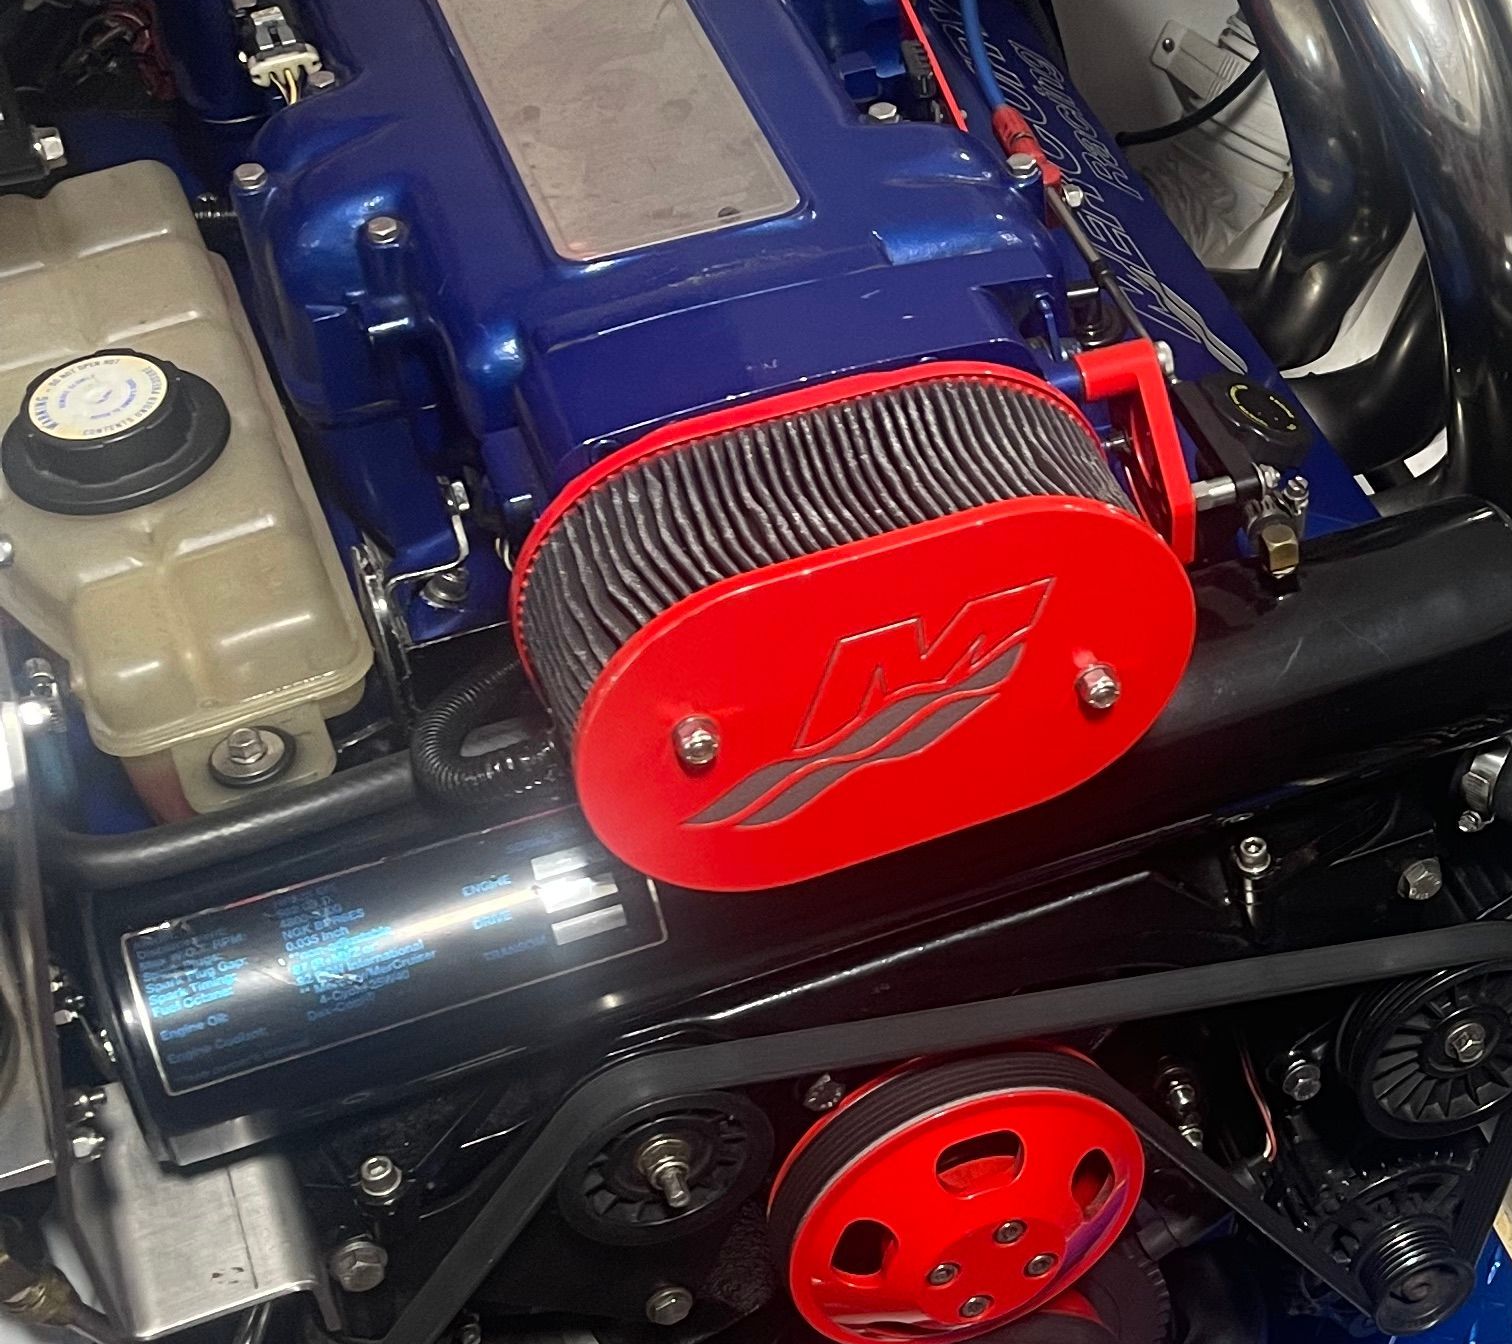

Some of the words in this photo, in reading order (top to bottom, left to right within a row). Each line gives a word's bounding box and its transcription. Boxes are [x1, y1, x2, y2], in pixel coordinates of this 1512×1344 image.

[1011, 39, 1143, 201] Racing
[35, 397, 59, 430] WARNING
[60, 368, 76, 379] NOT
[78, 361, 100, 370] OPEN
[82, 417, 135, 436] CONTENTS
[462, 874, 512, 897] ENGINE
[472, 910, 513, 930] DRIVE
[285, 934, 319, 951] 0.035
